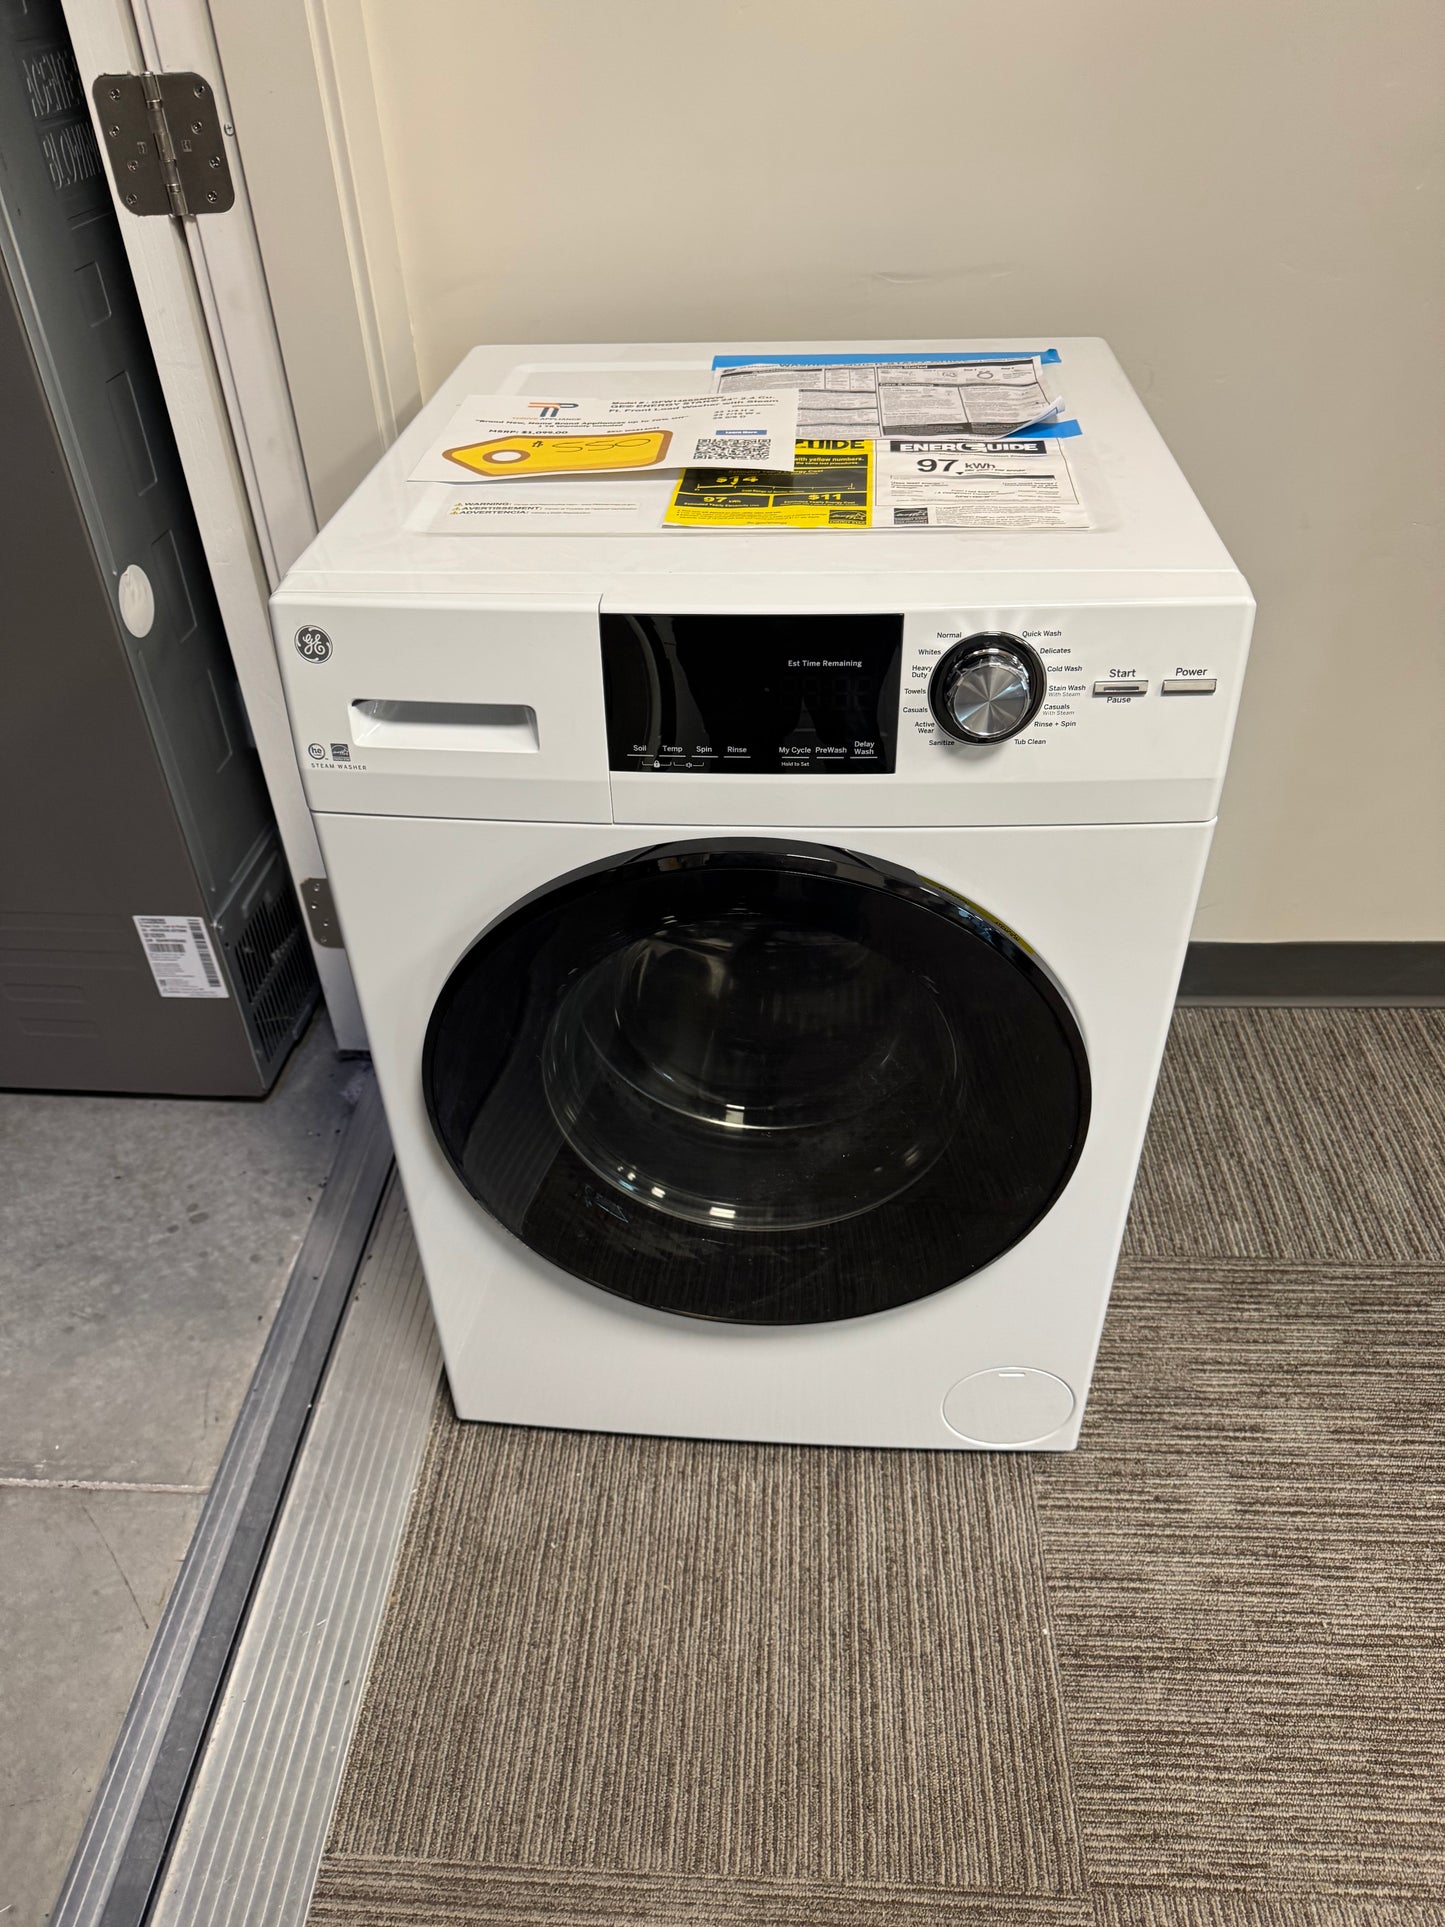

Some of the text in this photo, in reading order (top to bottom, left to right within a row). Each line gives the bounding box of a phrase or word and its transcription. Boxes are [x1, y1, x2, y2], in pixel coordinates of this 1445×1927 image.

[916, 458, 996, 473] 97 kWh
[808, 493, 842, 501] $11
[1022, 630, 1041, 638] Quick
[822, 660, 862, 668] Remaining
[1109, 668, 1136, 677] Start
[1175, 667, 1207, 676] Power
[633, 744, 646, 752] Soil
[661, 745, 684, 754] Temp
[696, 746, 712, 754] Spin
[792, 746, 811, 754] Cycle
[311, 762, 368, 771] STEAM WASHER
